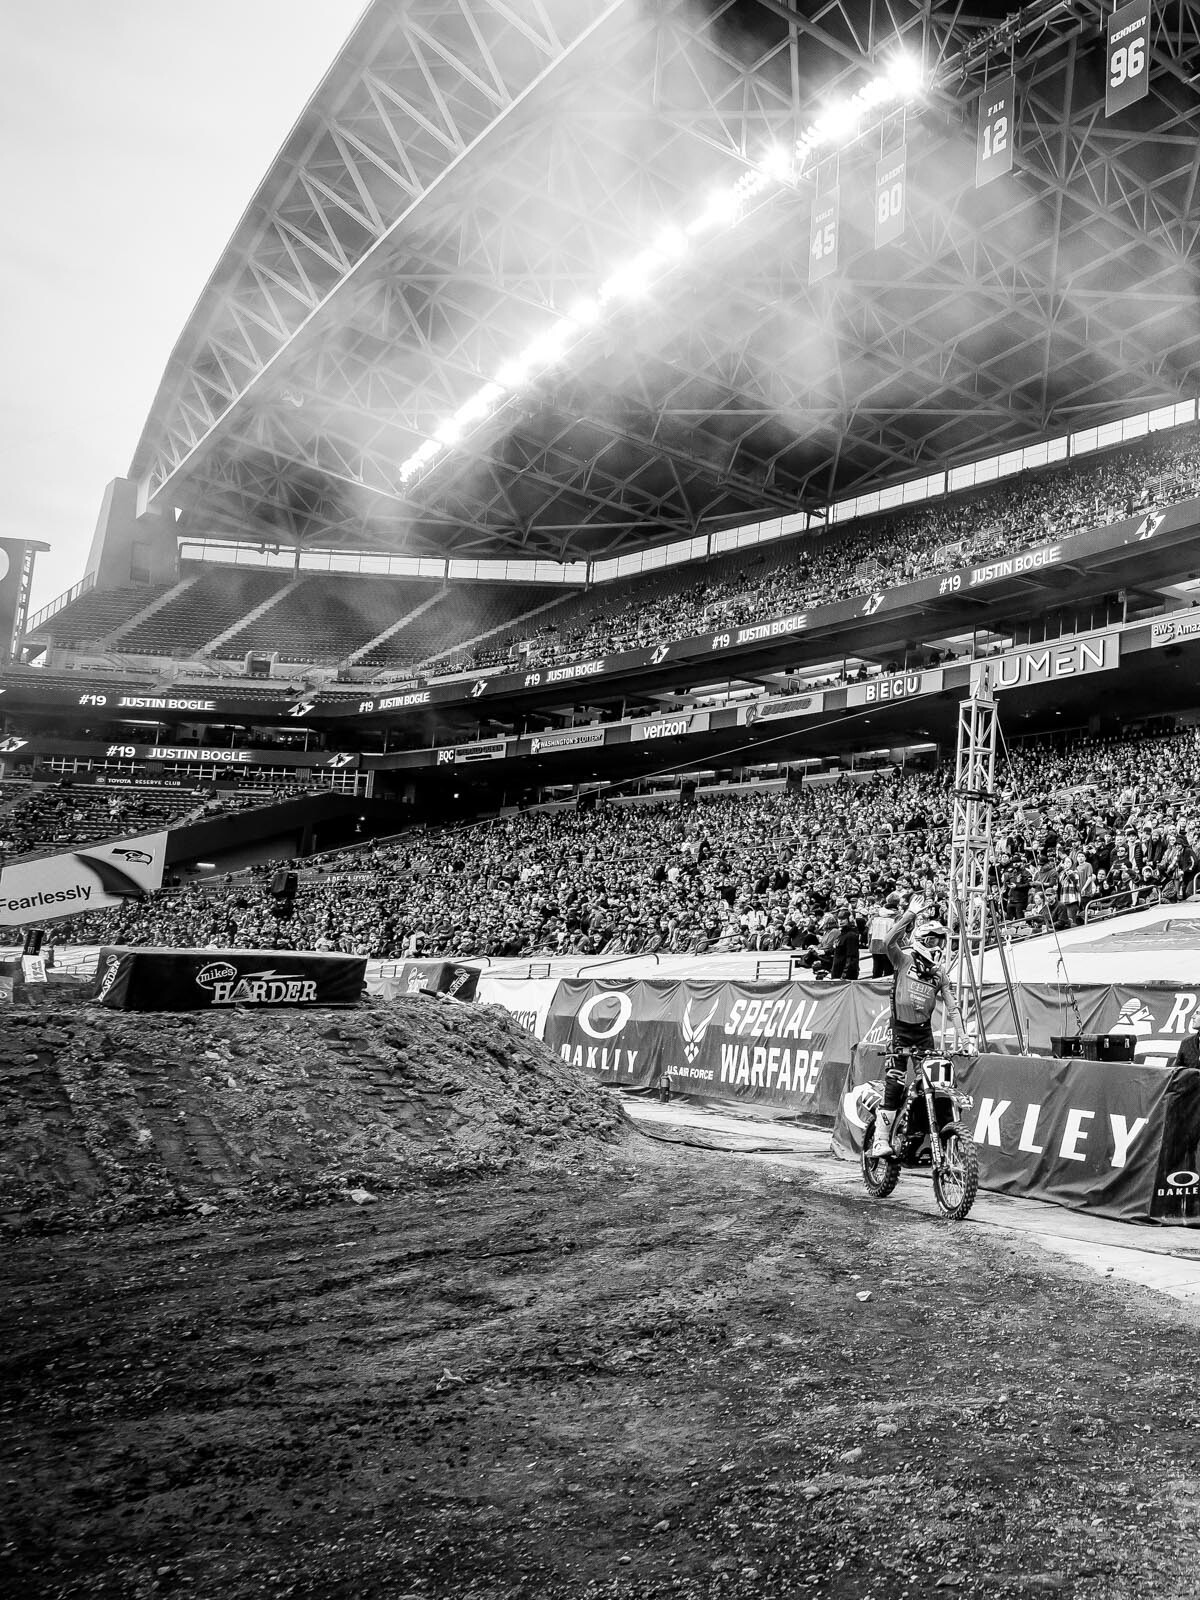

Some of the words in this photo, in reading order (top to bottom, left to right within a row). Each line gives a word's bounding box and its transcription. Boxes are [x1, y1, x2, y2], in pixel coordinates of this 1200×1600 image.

[1110, 15, 1147, 45] KENNEDY
[1110, 37, 1145, 88] 96
[987, 99, 1005, 117] FAN
[982, 116, 1008, 160] 12
[878, 182, 903, 225] 80
[811, 221, 836, 260] 45
[938, 574, 961, 596] #19
[969, 558, 1014, 588] JUSTIN
[1014, 545, 1061, 574] BOGLE
[711, 632, 731, 650] #19
[736, 622, 771, 645] JUSTIN
[771, 614, 807, 637] BOGLE
[1152, 622, 1175, 636] aws
[524, 673, 540, 687] #19
[546, 665, 575, 683] JUSTIN
[575, 660, 604, 678] BOGLE
[992, 639, 1105, 689] UMEN
[865, 675, 921, 701] BECU
[79, 694, 107, 706] #19
[118, 696, 166, 709] JUSTIN
[167, 698, 217, 711] BOGLE
[358, 701, 374, 713] #19
[378, 695, 404, 710] JUSTIN
[404, 691, 431, 706] BOGLE
[540, 736, 580, 749] WASHINGTON'S
[643, 720, 688, 739] verizon
[106, 745, 136, 759] #19
[148, 747, 199, 760] JUSTIN
[200, 749, 251, 763] BOGLE
[439, 749, 454, 763] EQC
[108, 777, 132, 785] TOYOTA
[200, 967, 234, 982] mike's
[211, 977, 318, 1004] HARDER
[724, 999, 819, 1040] SPECIAL
[689, 1068, 714, 1081] FORCE
[720, 1043, 824, 1095] WARFARE
[926, 1061, 954, 1083] 11
